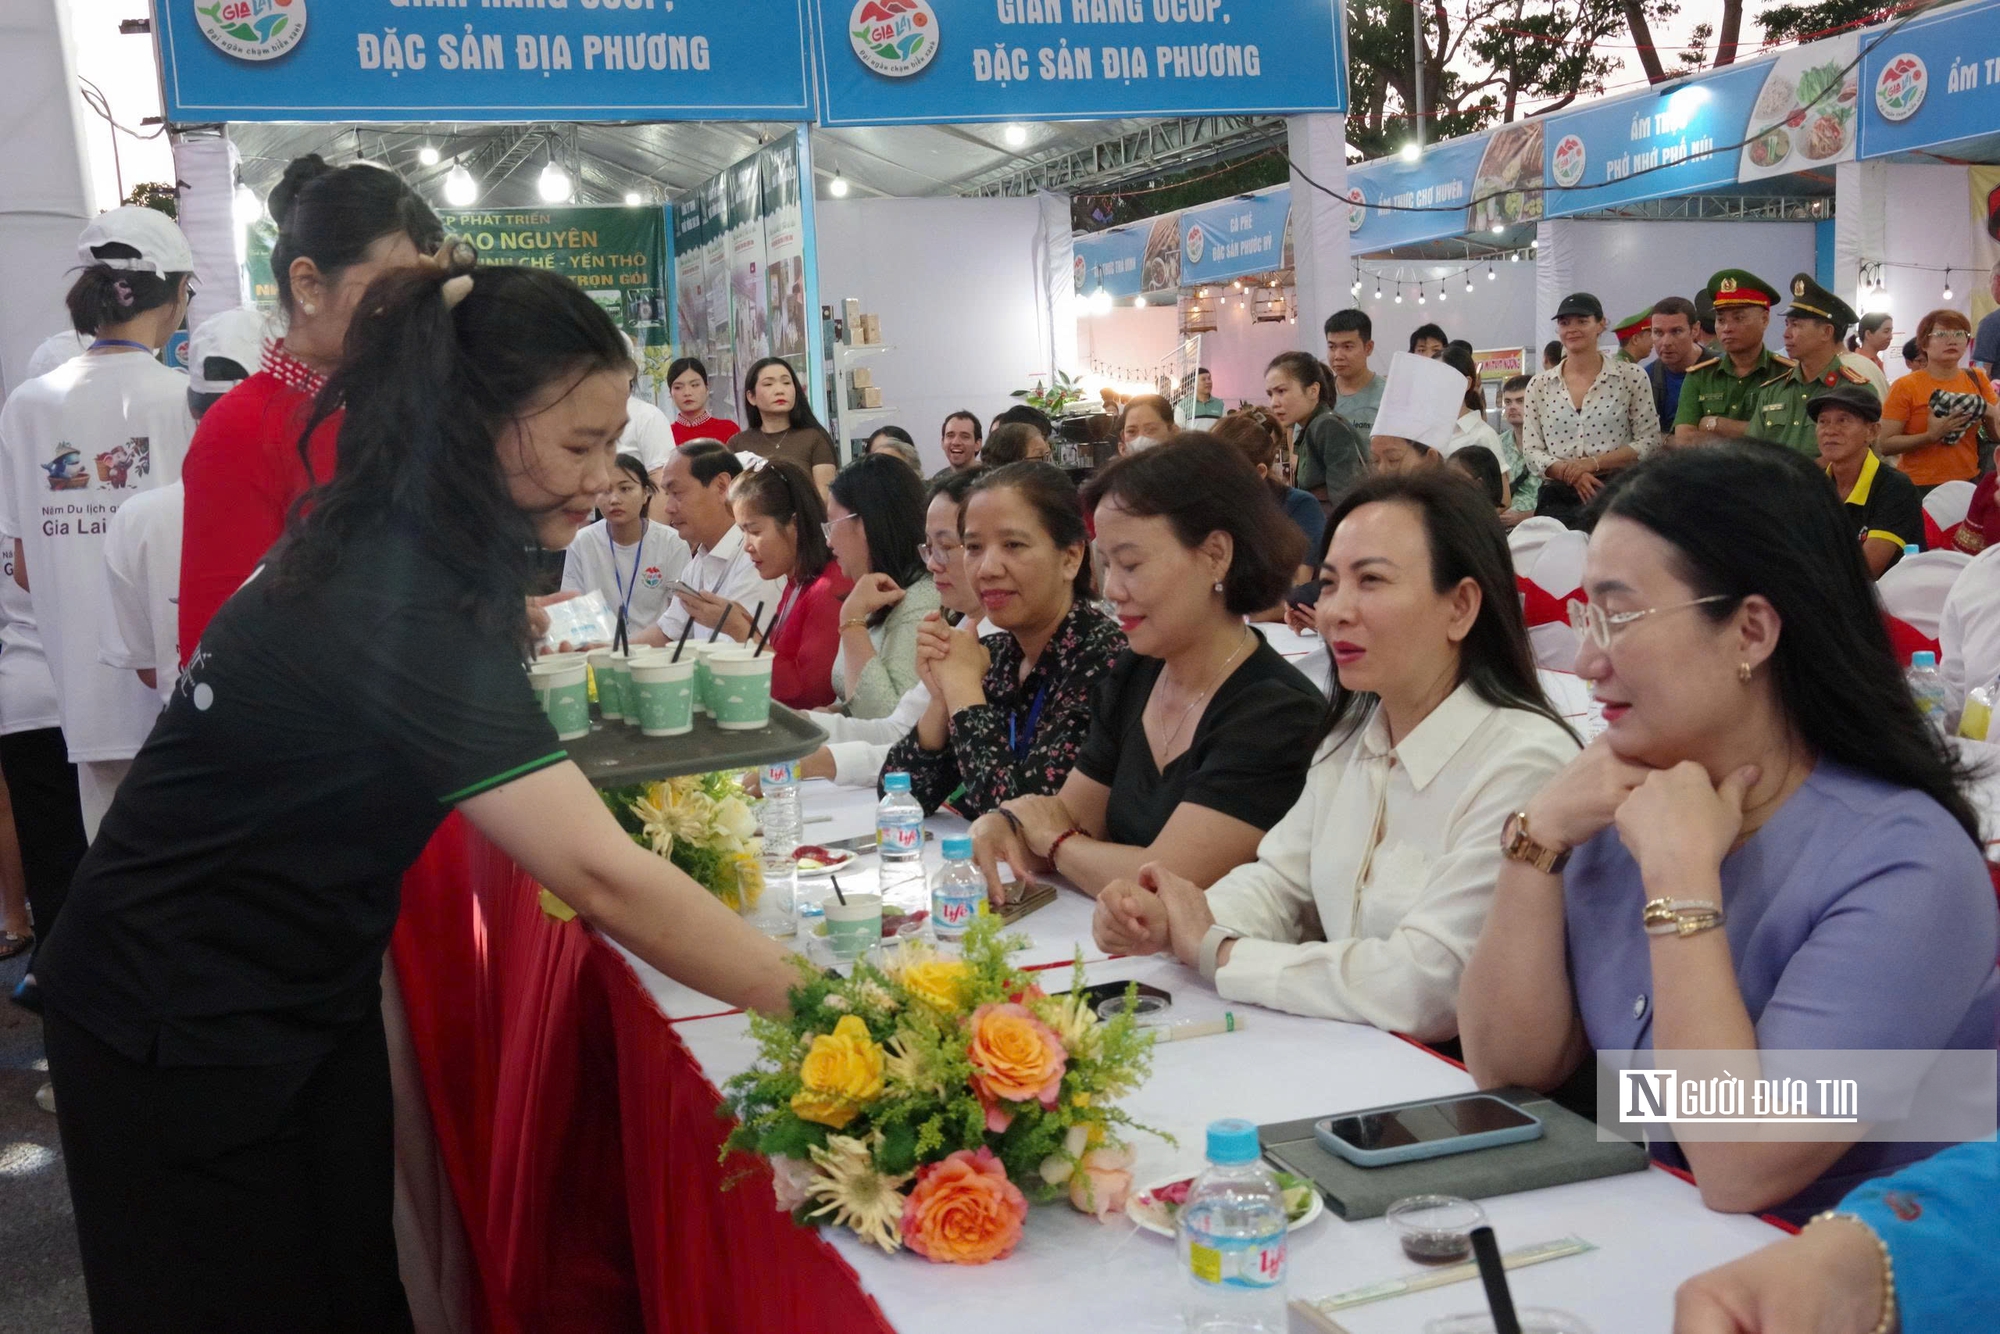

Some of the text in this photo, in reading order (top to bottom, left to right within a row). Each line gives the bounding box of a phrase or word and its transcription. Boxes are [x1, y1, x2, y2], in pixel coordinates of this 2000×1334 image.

[222, 1, 252, 20] GIA
[872, 14, 912, 42] GIA LAI
[357, 23, 711, 78] ĐẶC SẢN ĐỊA PHƯƠNG
[973, 38, 1261, 88] ĐẶC SẢN ĐỊA PHƯƠNG
[501, 228, 598, 249] NGUYÊN
[569, 252, 605, 268] YẾN
[608, 252, 648, 268] THÔ
[67, 504, 84, 515] Du
[86, 503, 106, 516] lịch
[42, 518, 107, 536] Gia Lai
